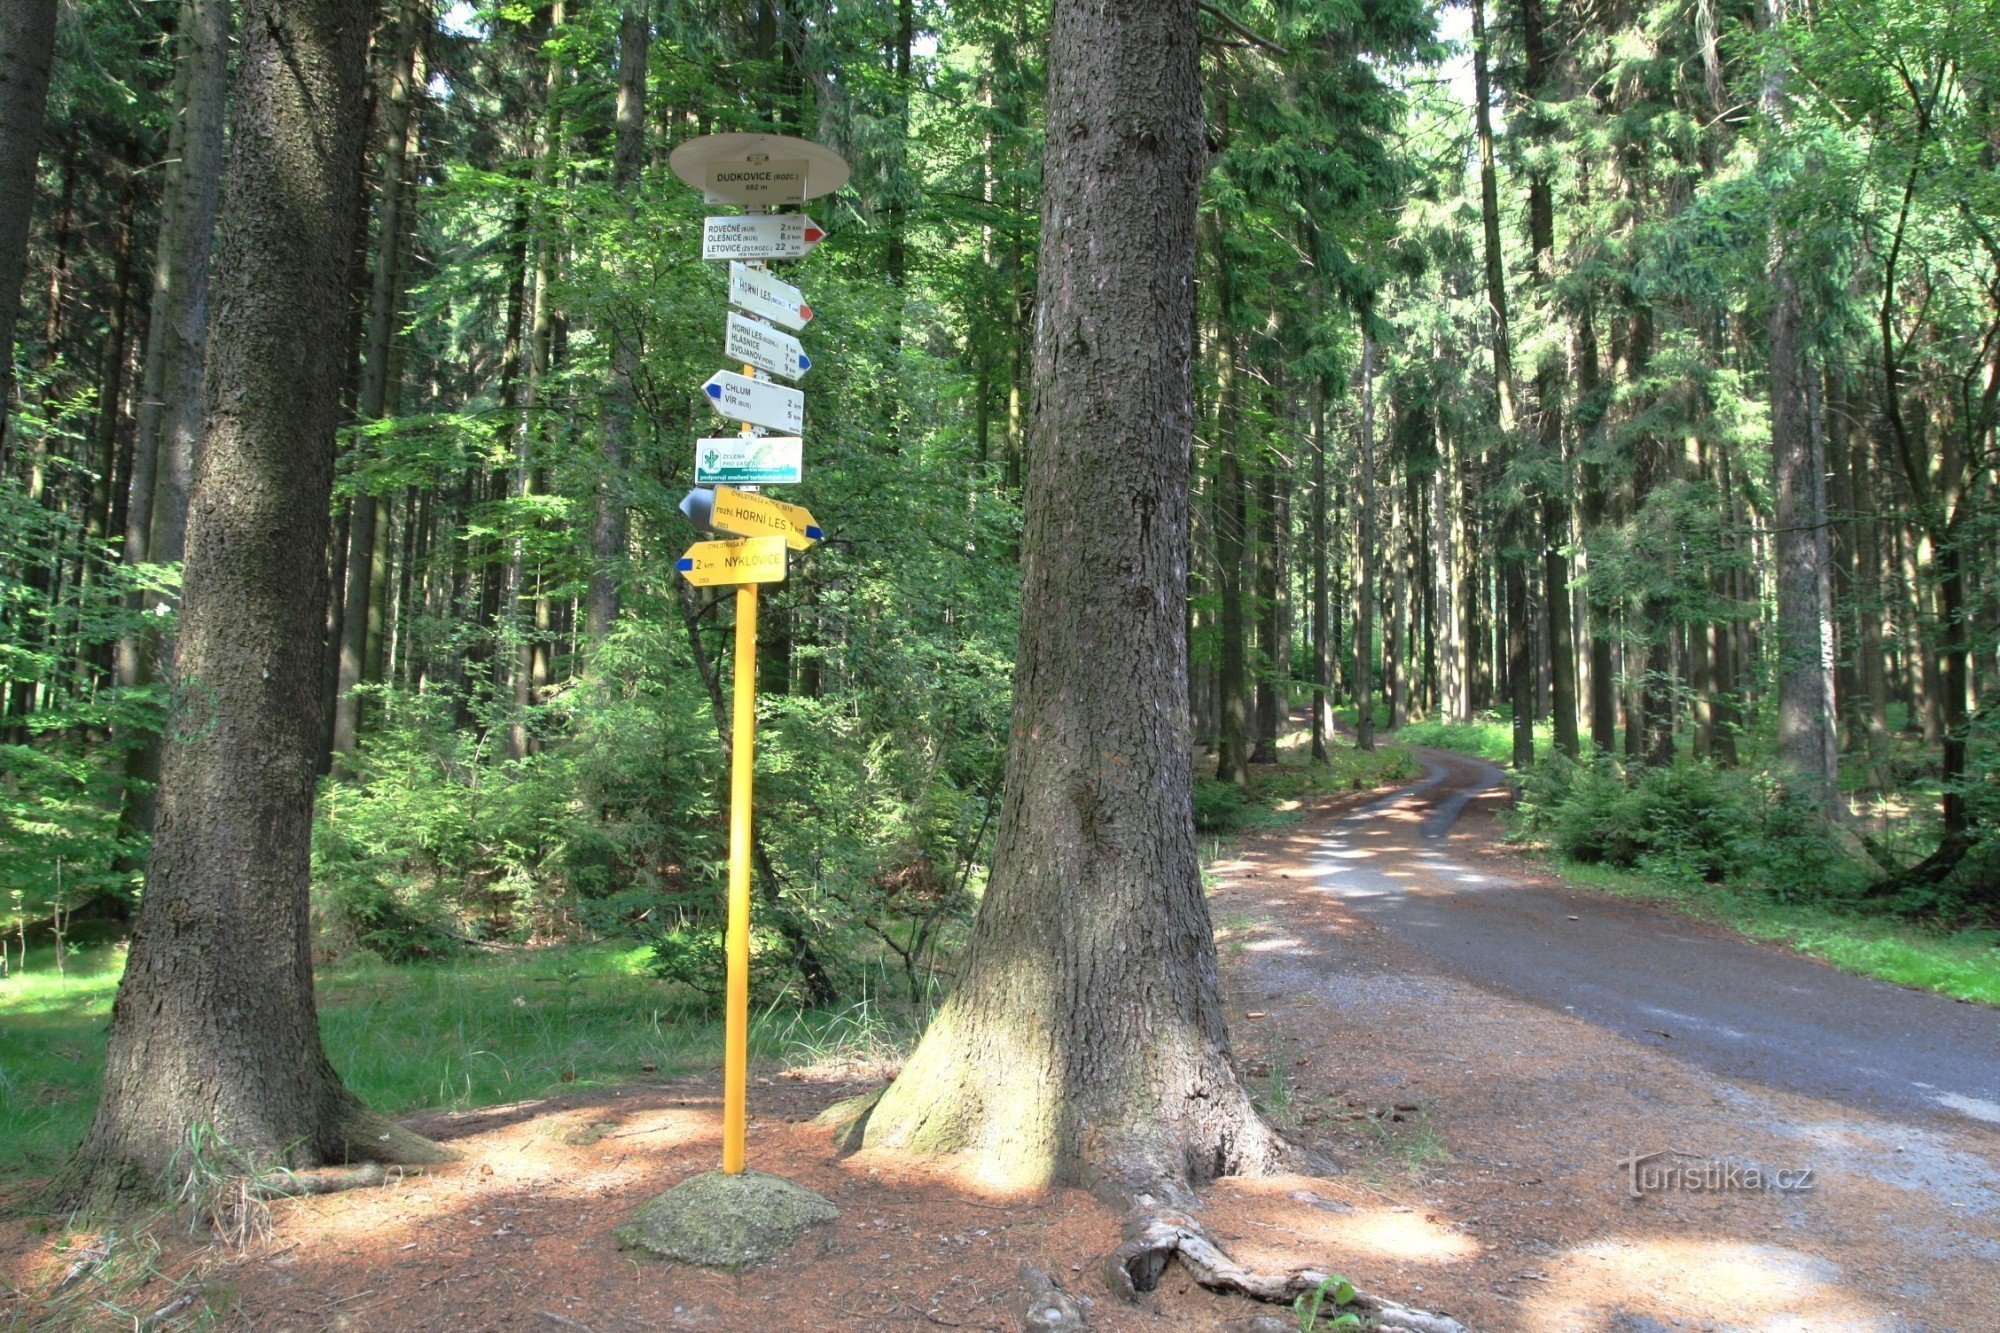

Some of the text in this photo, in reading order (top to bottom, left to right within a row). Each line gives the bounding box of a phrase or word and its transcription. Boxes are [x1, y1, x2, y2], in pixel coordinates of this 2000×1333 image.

[717, 172, 771, 182] DUDKOVICE
[708, 224, 741, 233] ROVEČNÉ
[707, 233, 742, 242] OLEŠNICE
[707, 244, 741, 253] LETOVICE
[775, 243, 786, 251] 22
[760, 288, 771, 301] LES
[731, 322, 751, 337] HORNÍ
[751, 329, 763, 341] LES
[785, 343, 789, 351] 1
[730, 343, 762, 361] SVOJANOV
[784, 363, 789, 371] 9
[785, 353, 789, 361] 7
[725, 383, 751, 397] CHLUM
[787, 399, 793, 408] 2
[787, 411, 792, 419] 5
[731, 490, 764, 504] CYKLOTRASA
[735, 507, 766, 525] HORNÍ
[768, 516, 786, 530] LES
[794, 526, 804, 535] km
[707, 541, 739, 550] CYKLOTRASA
[696, 559, 702, 570] 2
[724, 553, 781, 568] NYKLOVICE
